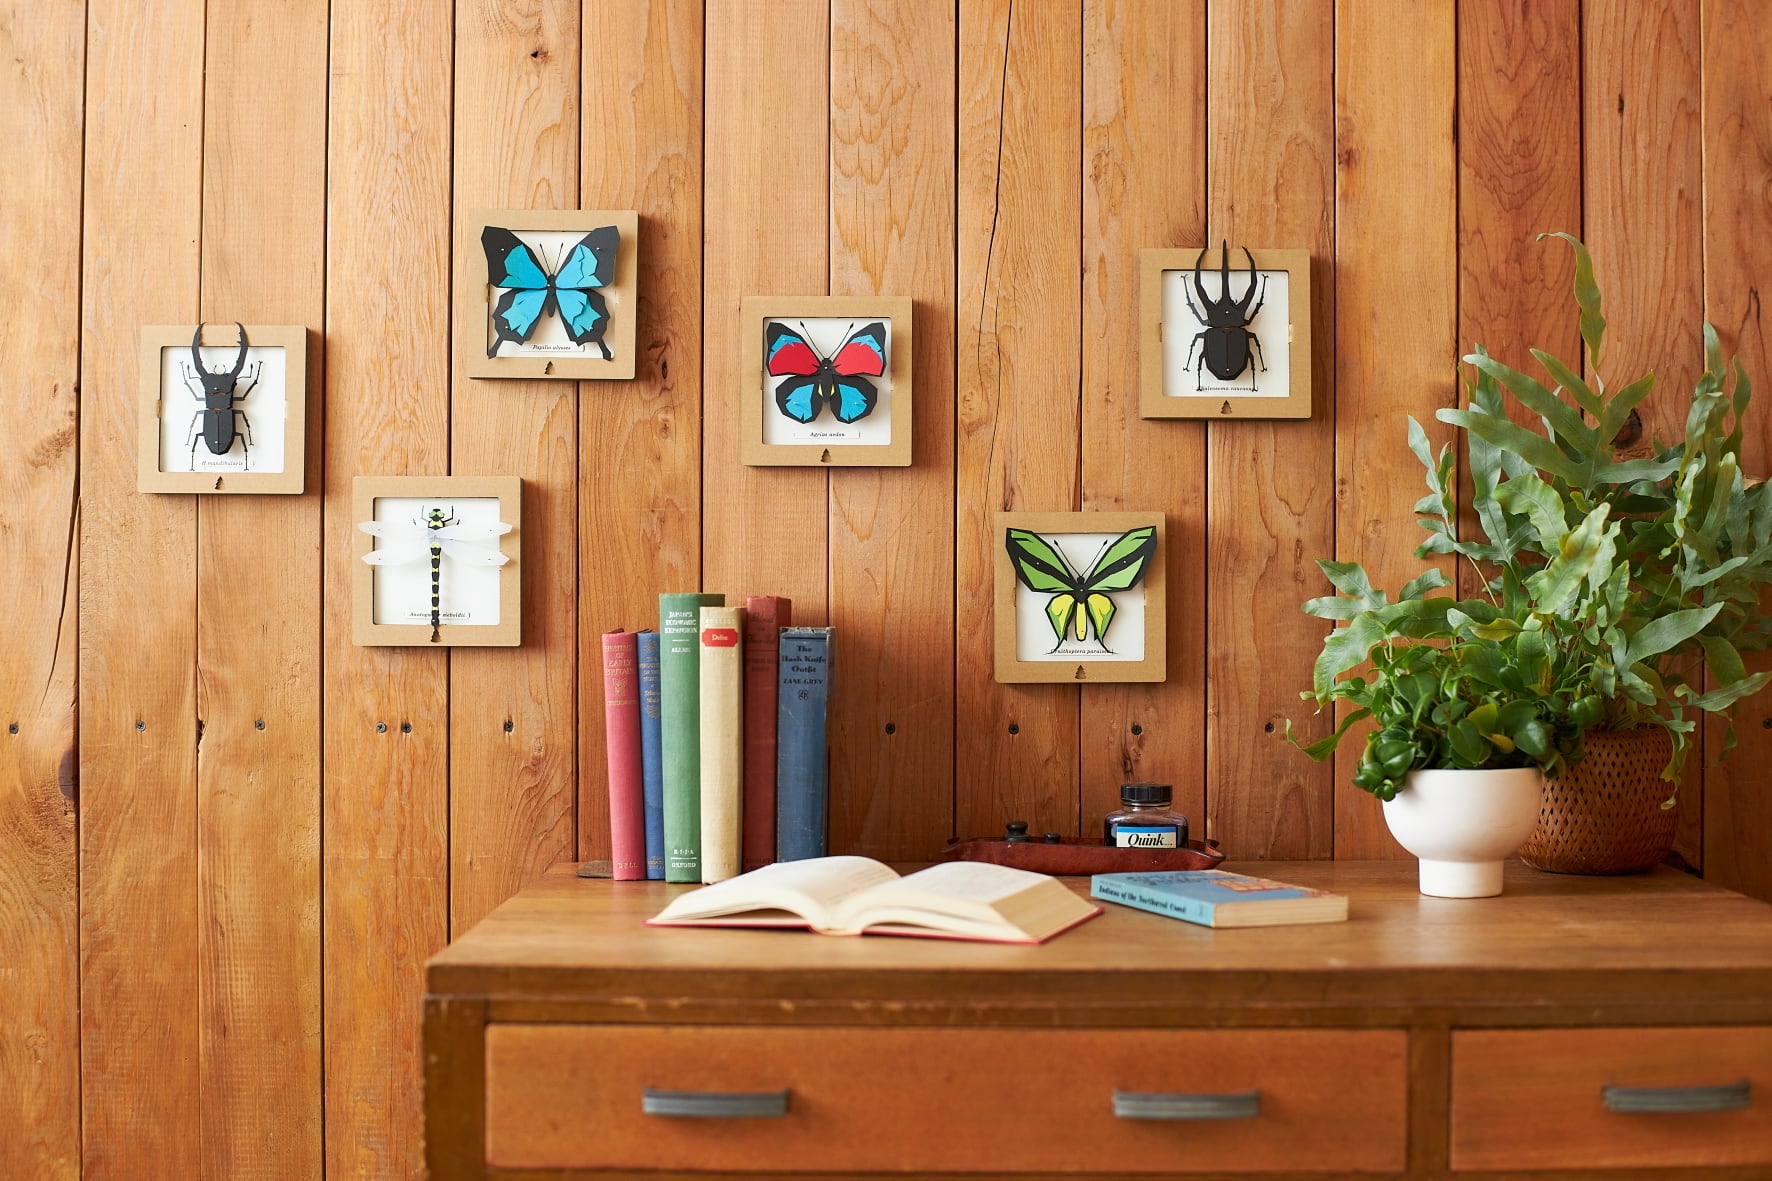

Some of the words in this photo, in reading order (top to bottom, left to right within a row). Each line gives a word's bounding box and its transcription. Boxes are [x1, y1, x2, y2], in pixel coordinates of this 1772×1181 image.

[607, 659, 632, 667] EARLY
[804, 655, 827, 663] Knife
[791, 665, 817, 673] Outfit
[1127, 833, 1165, 848] Quink
[1098, 885, 1120, 897] Indians
[1121, 891, 1127, 900] of
[1127, 892, 1137, 900] the
